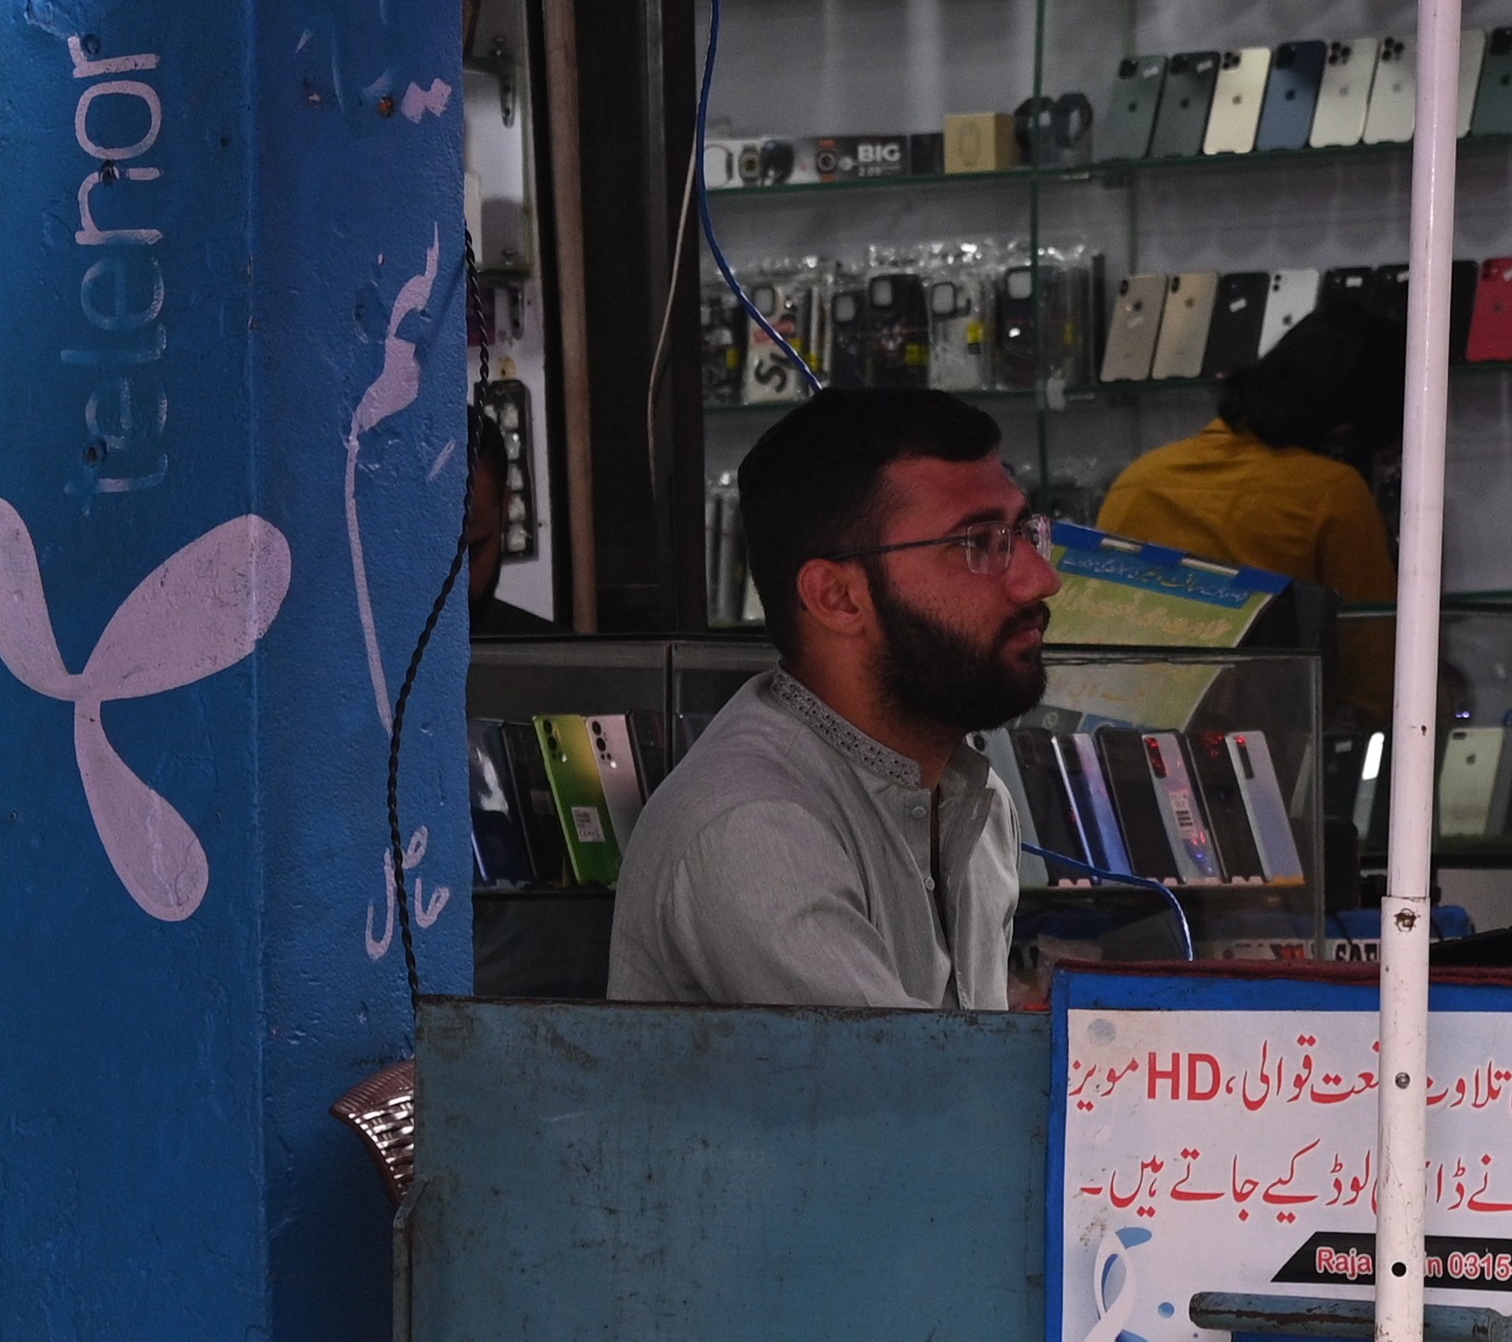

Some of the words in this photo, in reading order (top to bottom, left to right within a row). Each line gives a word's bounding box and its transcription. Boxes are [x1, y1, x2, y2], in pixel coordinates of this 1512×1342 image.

[857, 143, 900, 163] BIG
[61, 35, 168, 516] telenor
[1068, 1056, 1139, 1112] مویز
[1146, 1051, 1222, 1102] HD
[1170, 1147, 1260, 1222] جاتے
[1315, 1245, 1372, 1280] Raja
